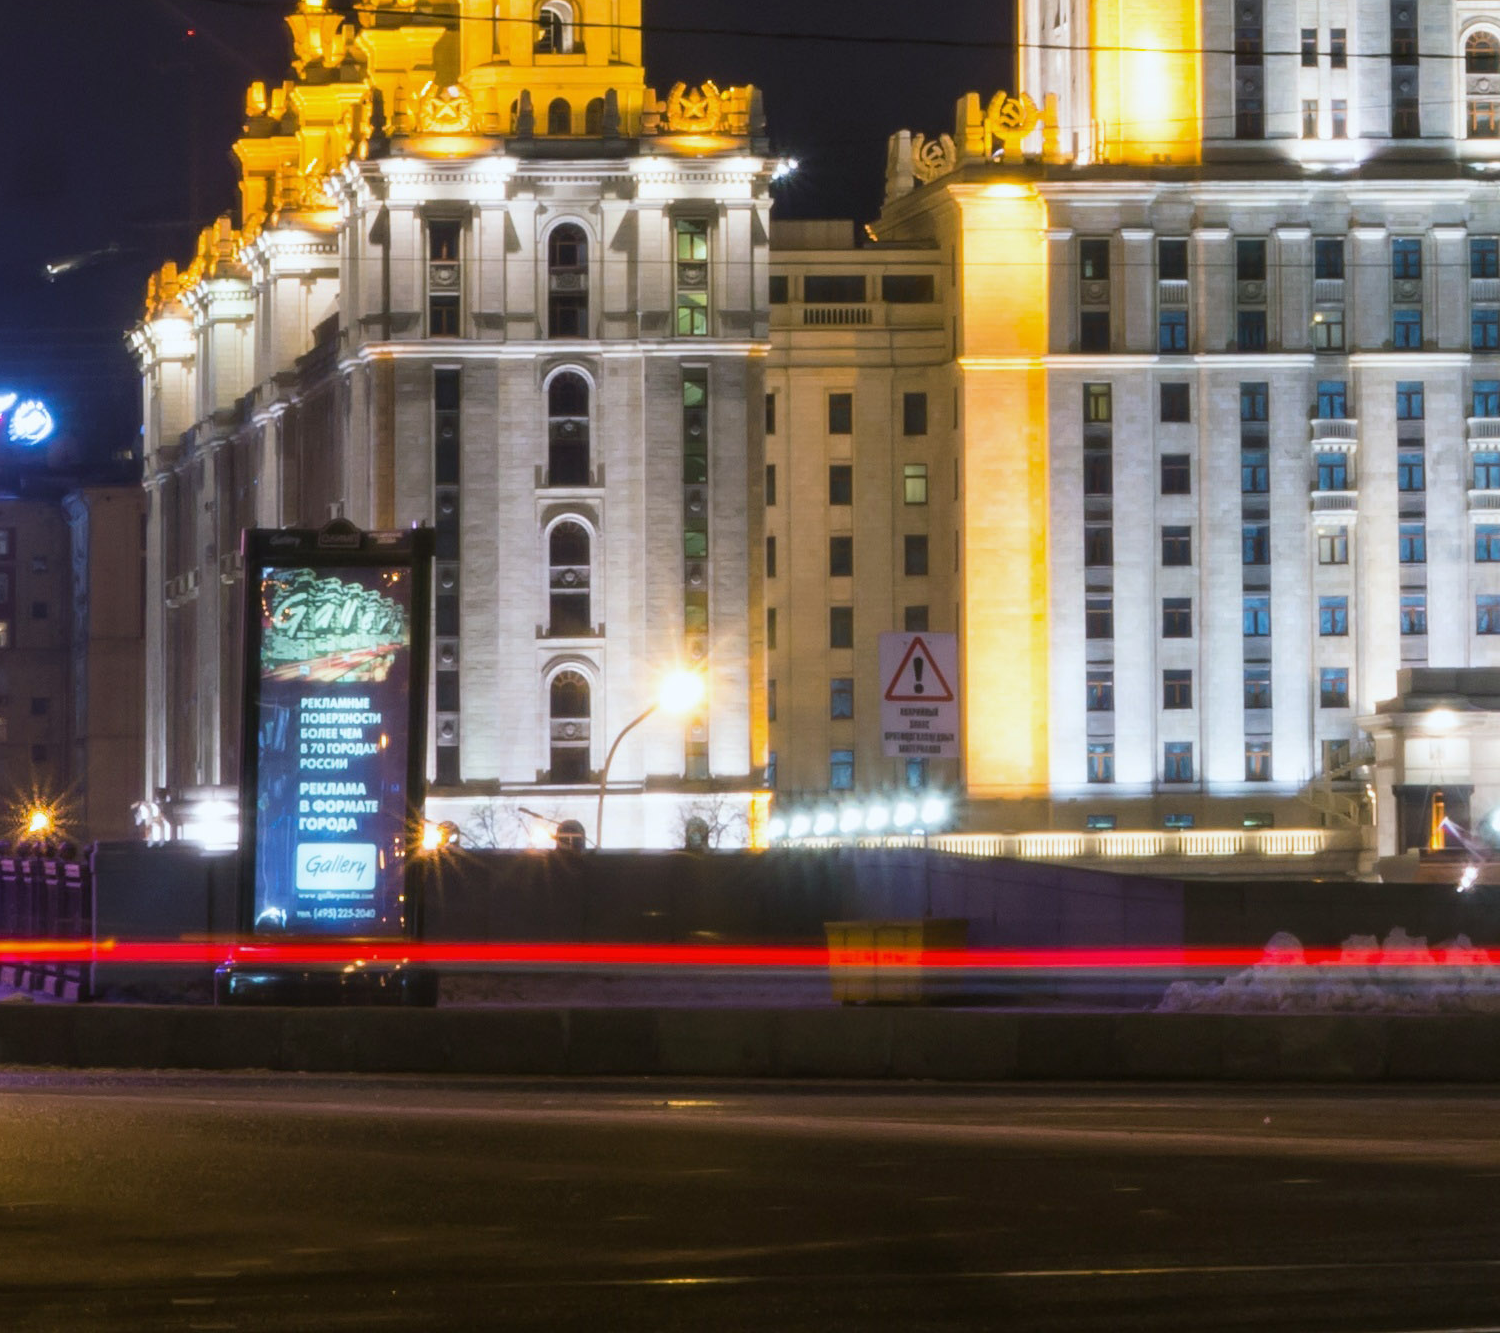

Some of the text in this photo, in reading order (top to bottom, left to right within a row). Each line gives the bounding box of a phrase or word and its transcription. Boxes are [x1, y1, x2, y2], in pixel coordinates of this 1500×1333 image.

[301, 697, 370, 709] РЕКЛАМНЫЕ
[300, 713, 381, 724] ПОВЕРХНОСТИ
[300, 728, 363, 739] БОЛЕЕ ЧЕМ
[300, 743, 378, 756] В 70 ГОРОДАХ
[300, 758, 348, 769] РОССИИ
[300, 782, 367, 795] РЕКЛАМА
[299, 799, 378, 813] В ФОРМАТЕ
[299, 817, 358, 832] ГОРОДА
[306, 854, 367, 882] Gallery
